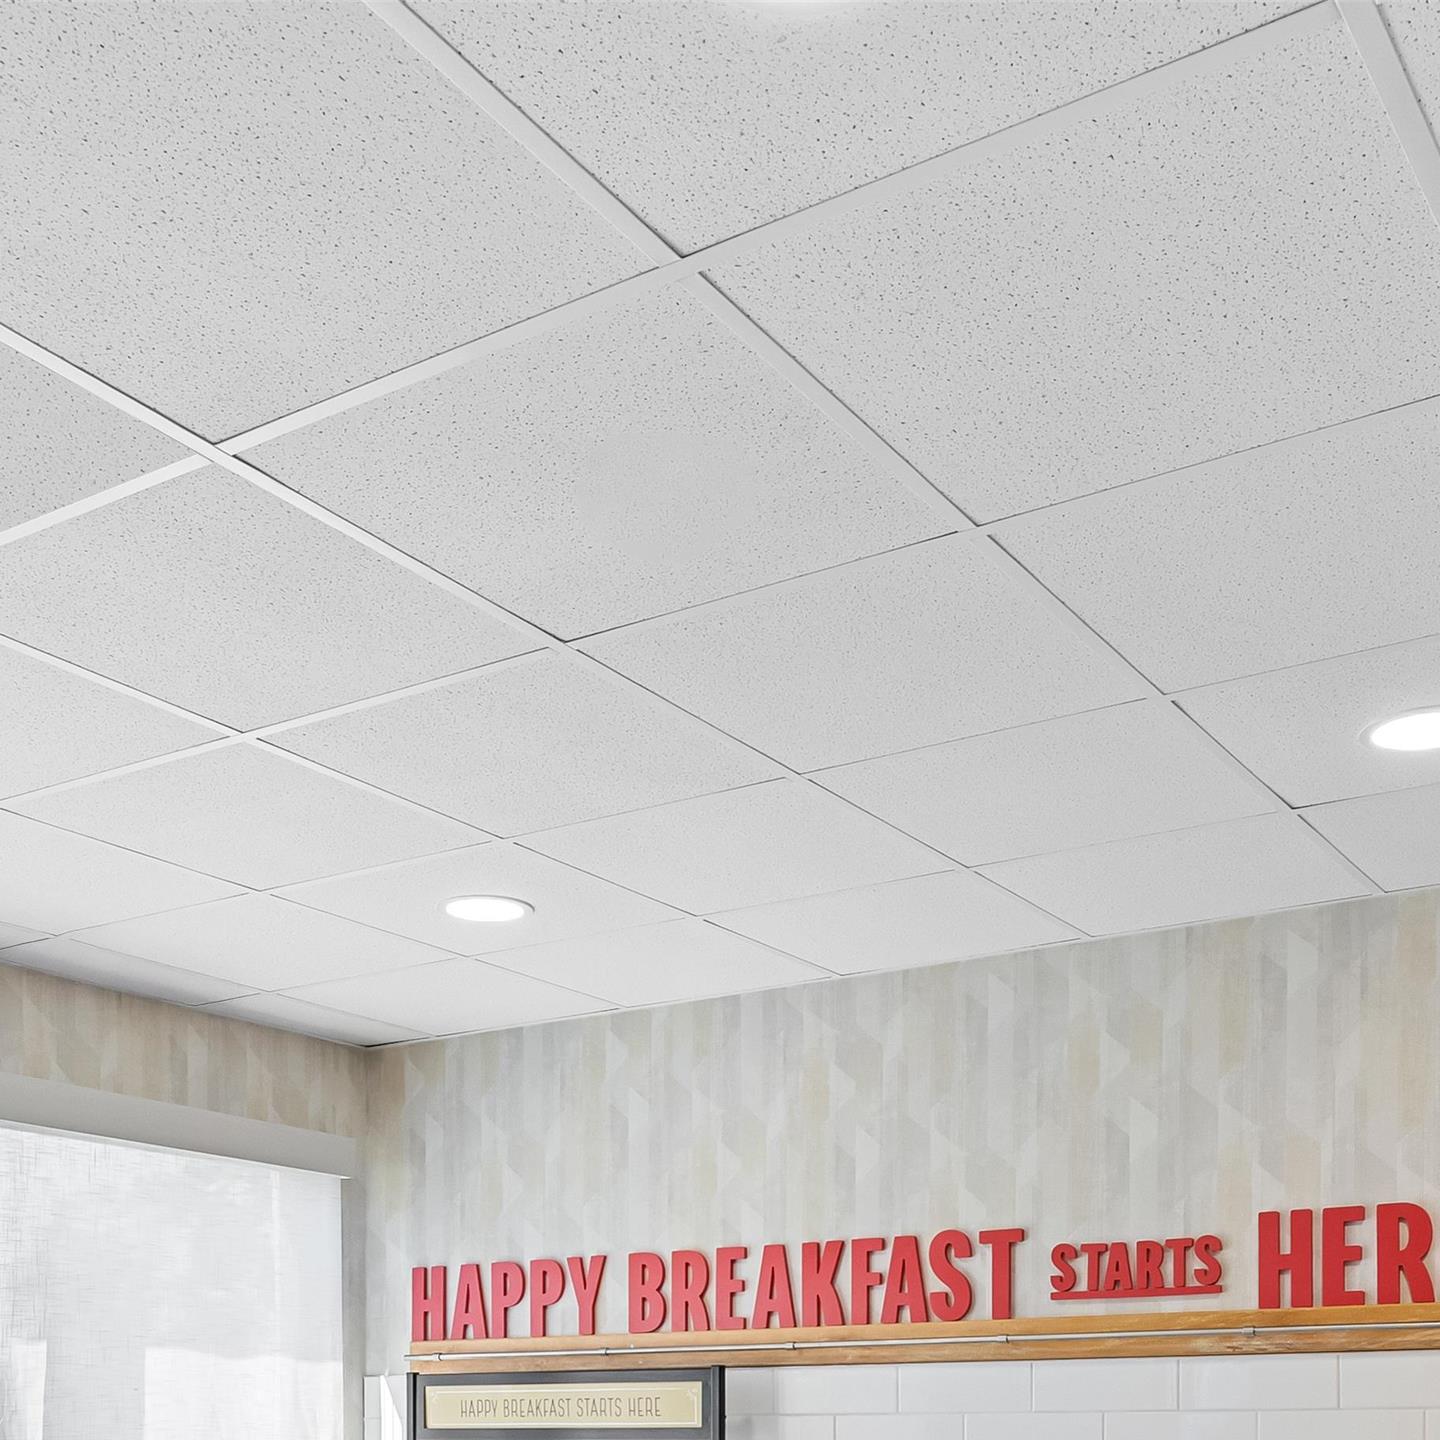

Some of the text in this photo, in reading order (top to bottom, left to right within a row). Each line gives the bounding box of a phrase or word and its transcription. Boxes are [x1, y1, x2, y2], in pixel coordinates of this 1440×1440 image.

[412, 1256, 607, 1341] HAPPY
[628, 1228, 1024, 1334] BREAKFAST
[1050, 1235, 1223, 1292] STARTS
[460, 1396, 662, 1418] HAPPY BREAKFAST STARTS HERE
